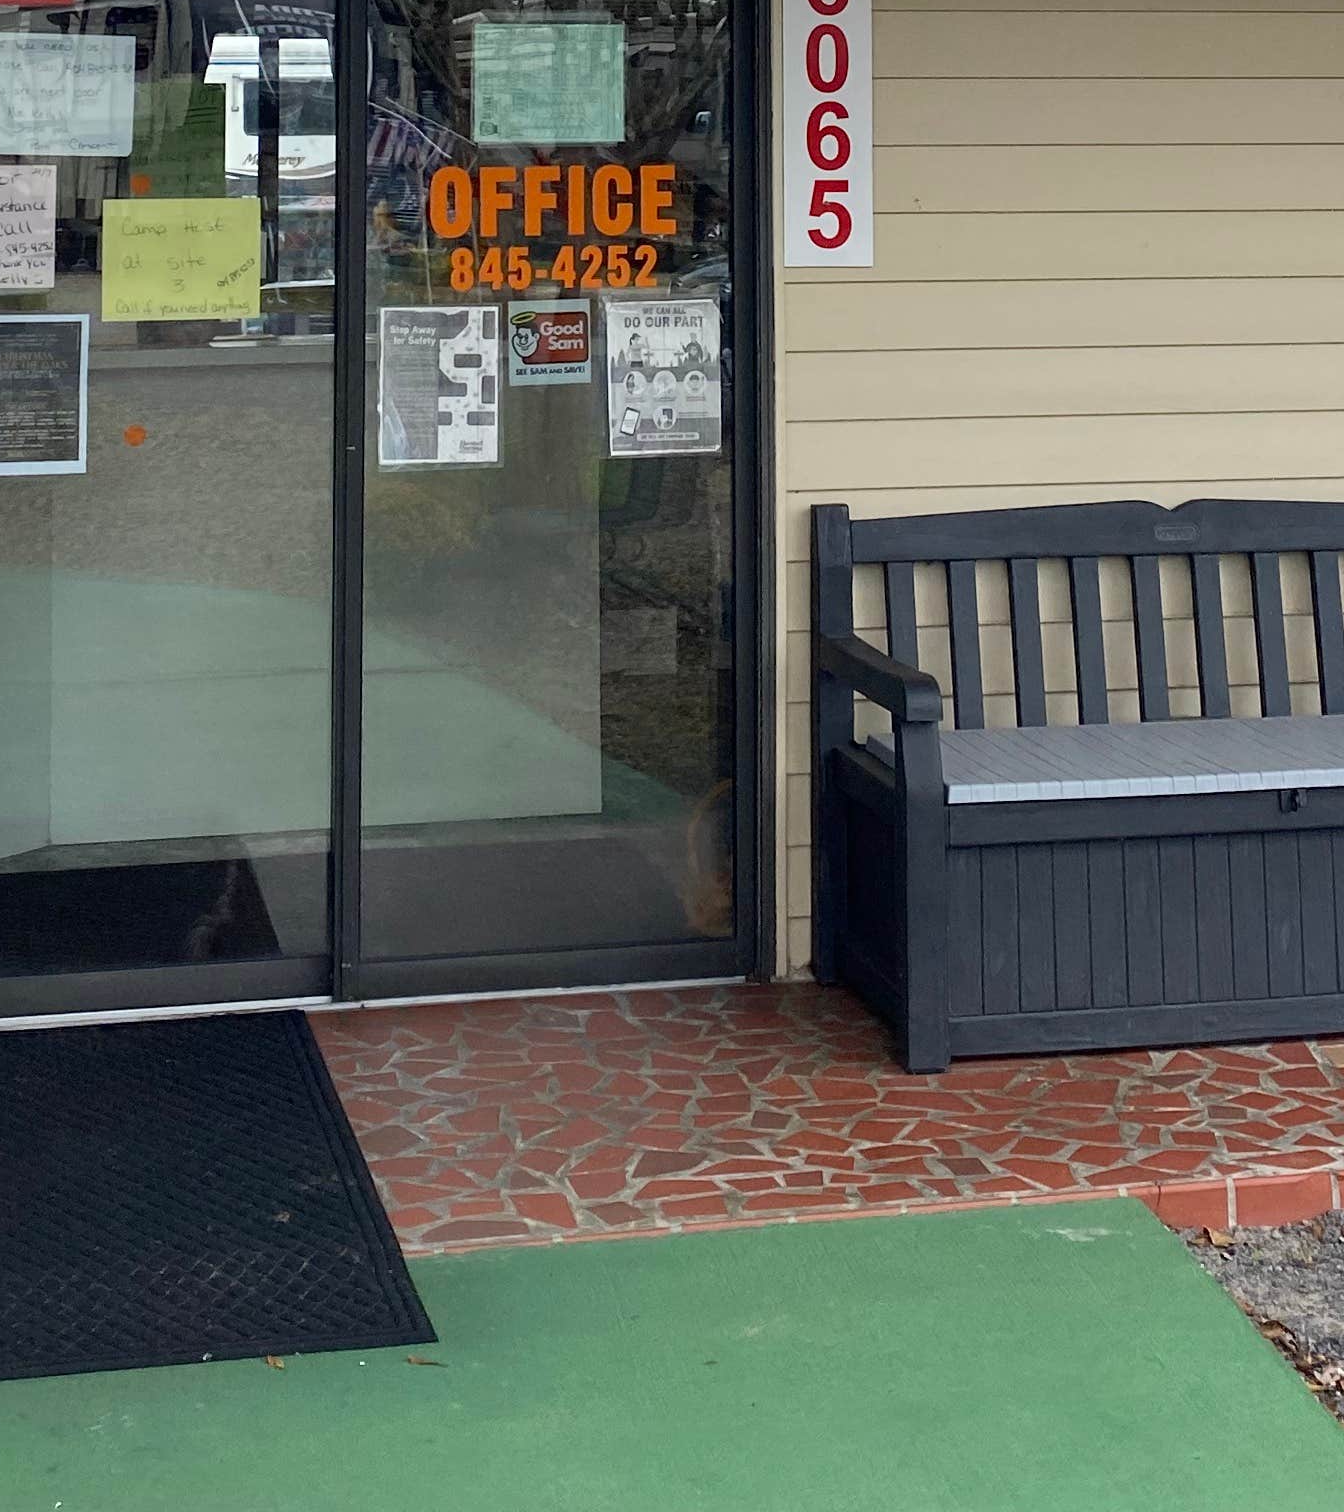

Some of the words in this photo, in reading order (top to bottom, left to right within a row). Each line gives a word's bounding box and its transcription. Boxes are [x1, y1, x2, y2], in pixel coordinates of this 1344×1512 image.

[429, 164, 677, 239] OFFICE
[450, 244, 658, 293] 845-4252
[540, 320, 584, 336] Good
[624, 316, 641, 328] DO
[645, 316, 670, 328] OUR
[674, 315, 704, 328] PART
[412, 325, 436, 335] Away
[408, 336, 436, 347] Safety
[548, 335, 584, 351] Sam
[529, 367, 548, 375] SAM
